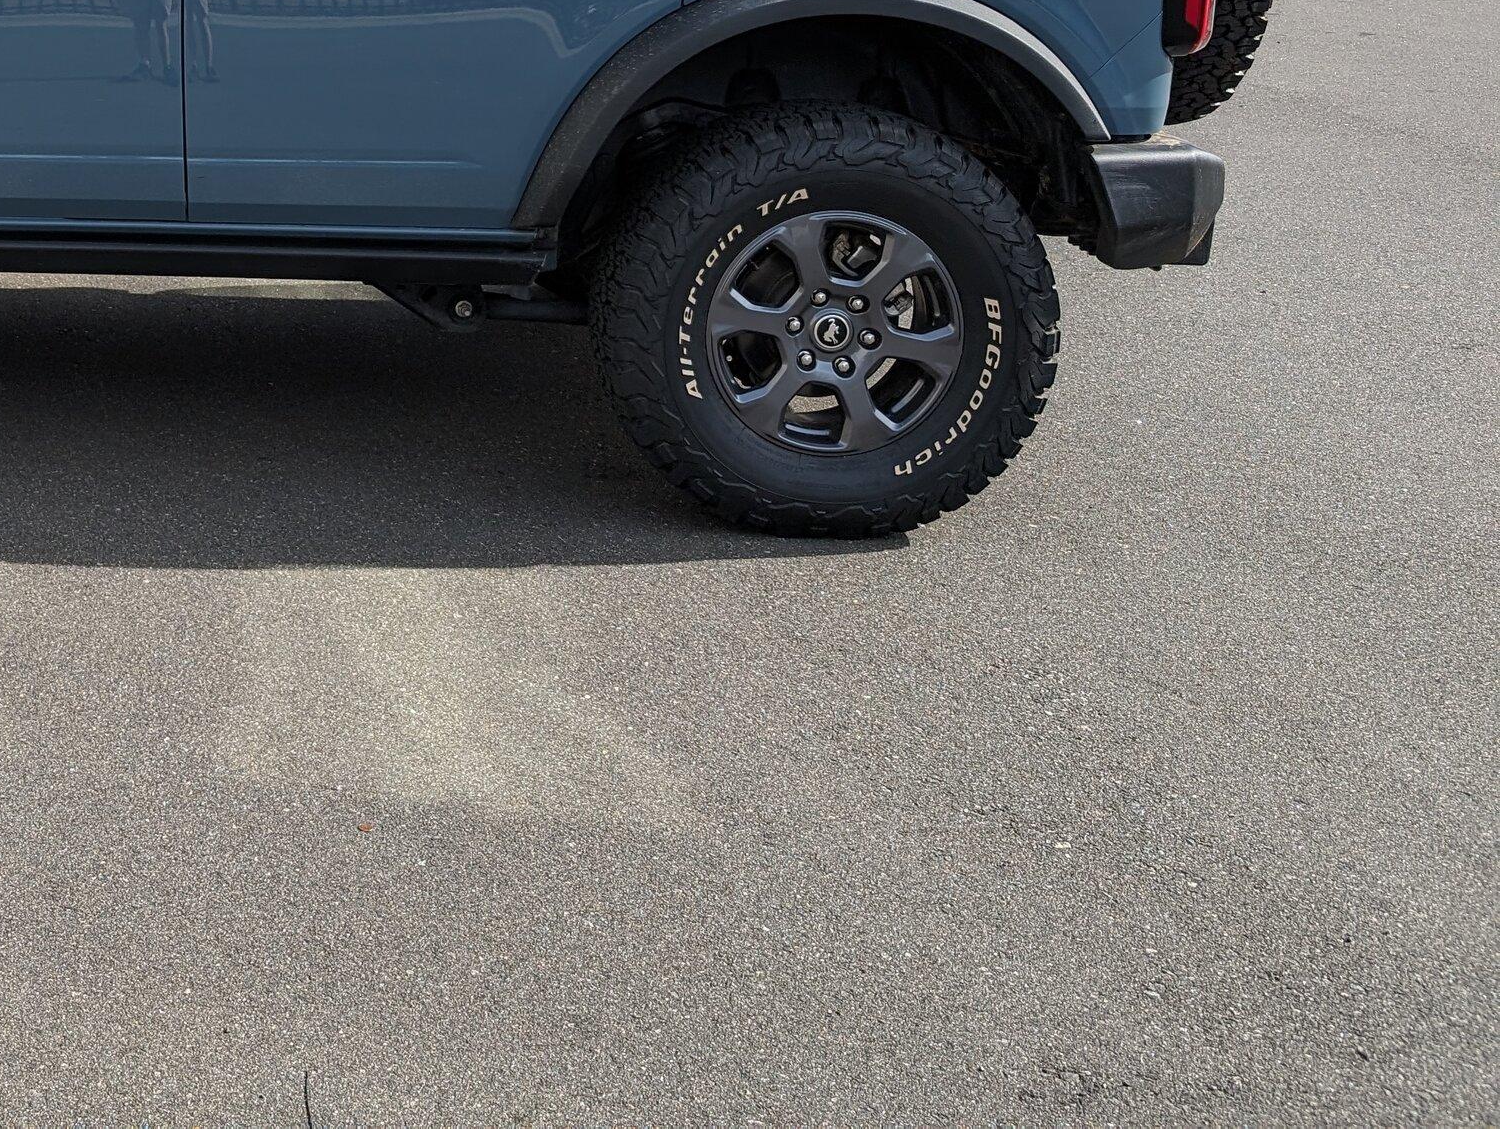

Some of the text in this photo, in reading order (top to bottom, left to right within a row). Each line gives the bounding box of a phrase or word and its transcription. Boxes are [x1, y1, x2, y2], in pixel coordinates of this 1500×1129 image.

[678, 188, 809, 400] All-Terrain T/A
[894, 297, 1002, 477] BFGoodrich
